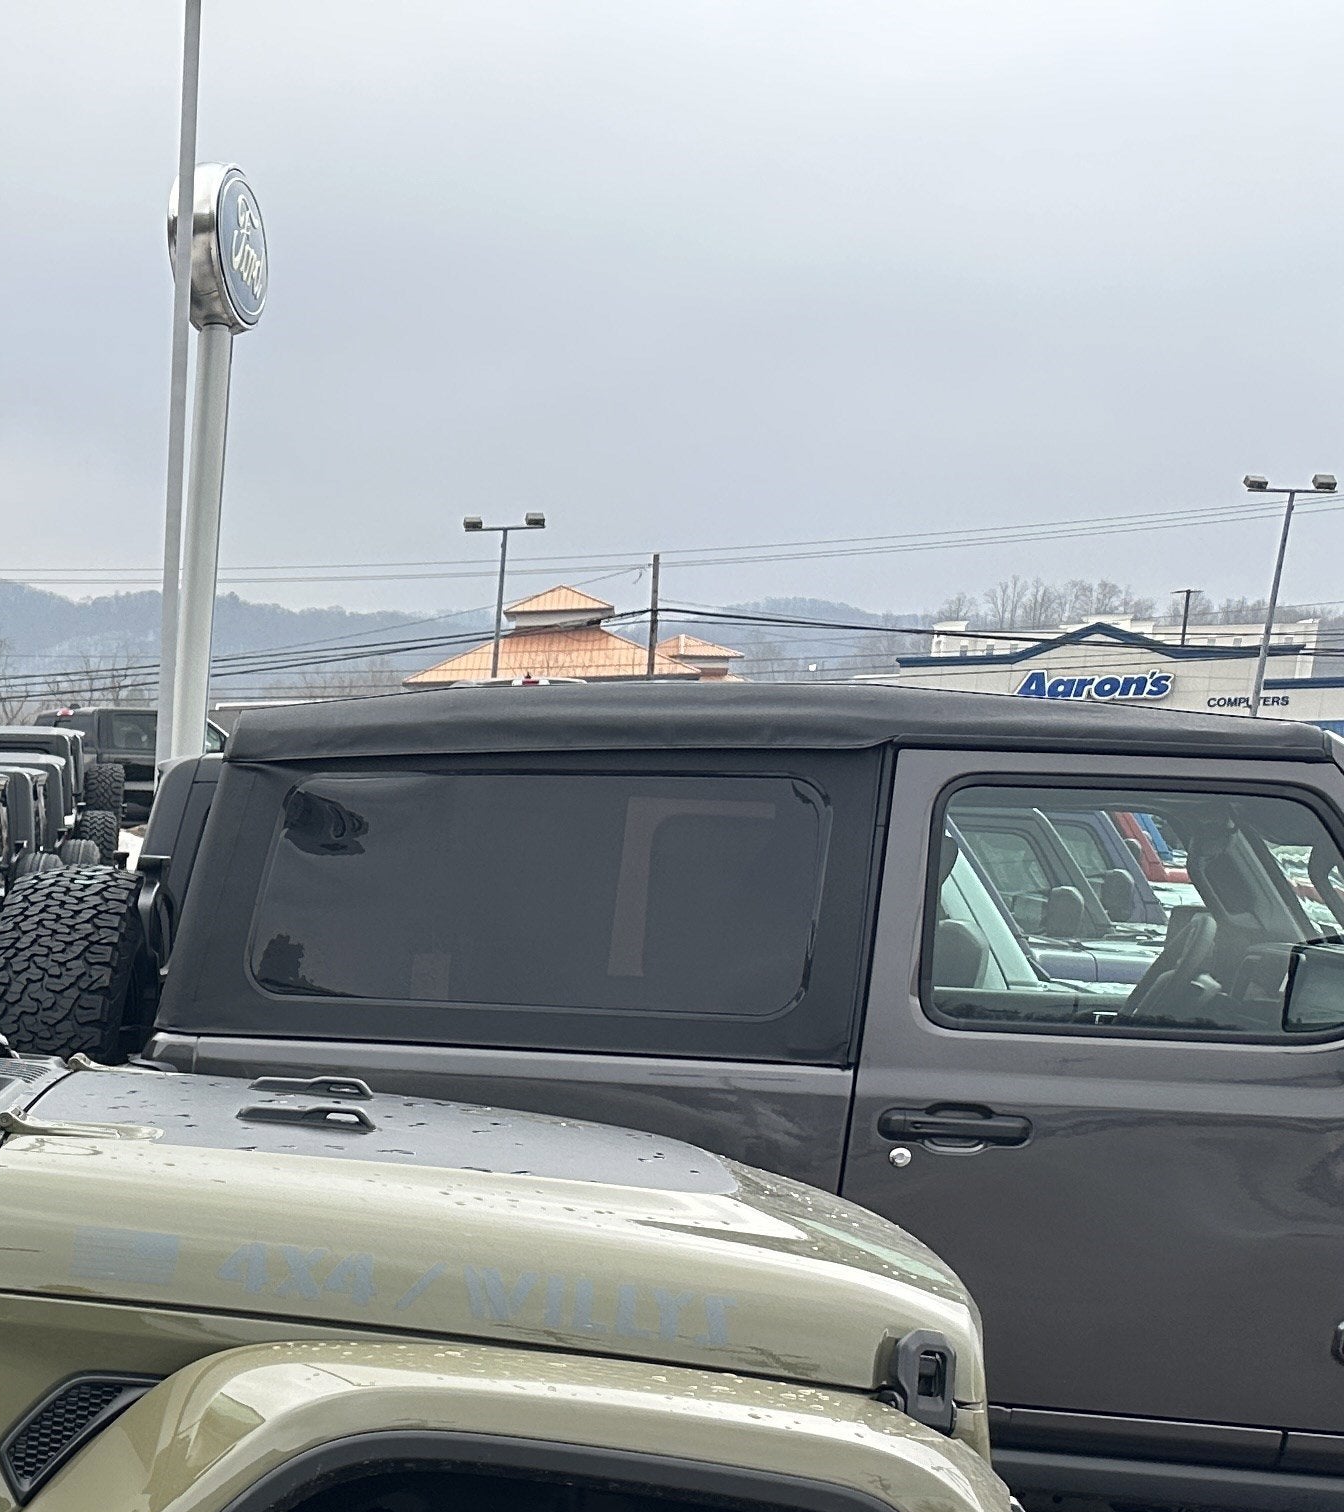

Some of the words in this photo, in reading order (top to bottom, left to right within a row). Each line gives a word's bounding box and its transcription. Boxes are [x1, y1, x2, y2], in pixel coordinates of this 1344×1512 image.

[231, 194, 264, 300] Ford
[1015, 670, 1173, 699] Aaron's
[462, 1267, 737, 1346] WILLYS
